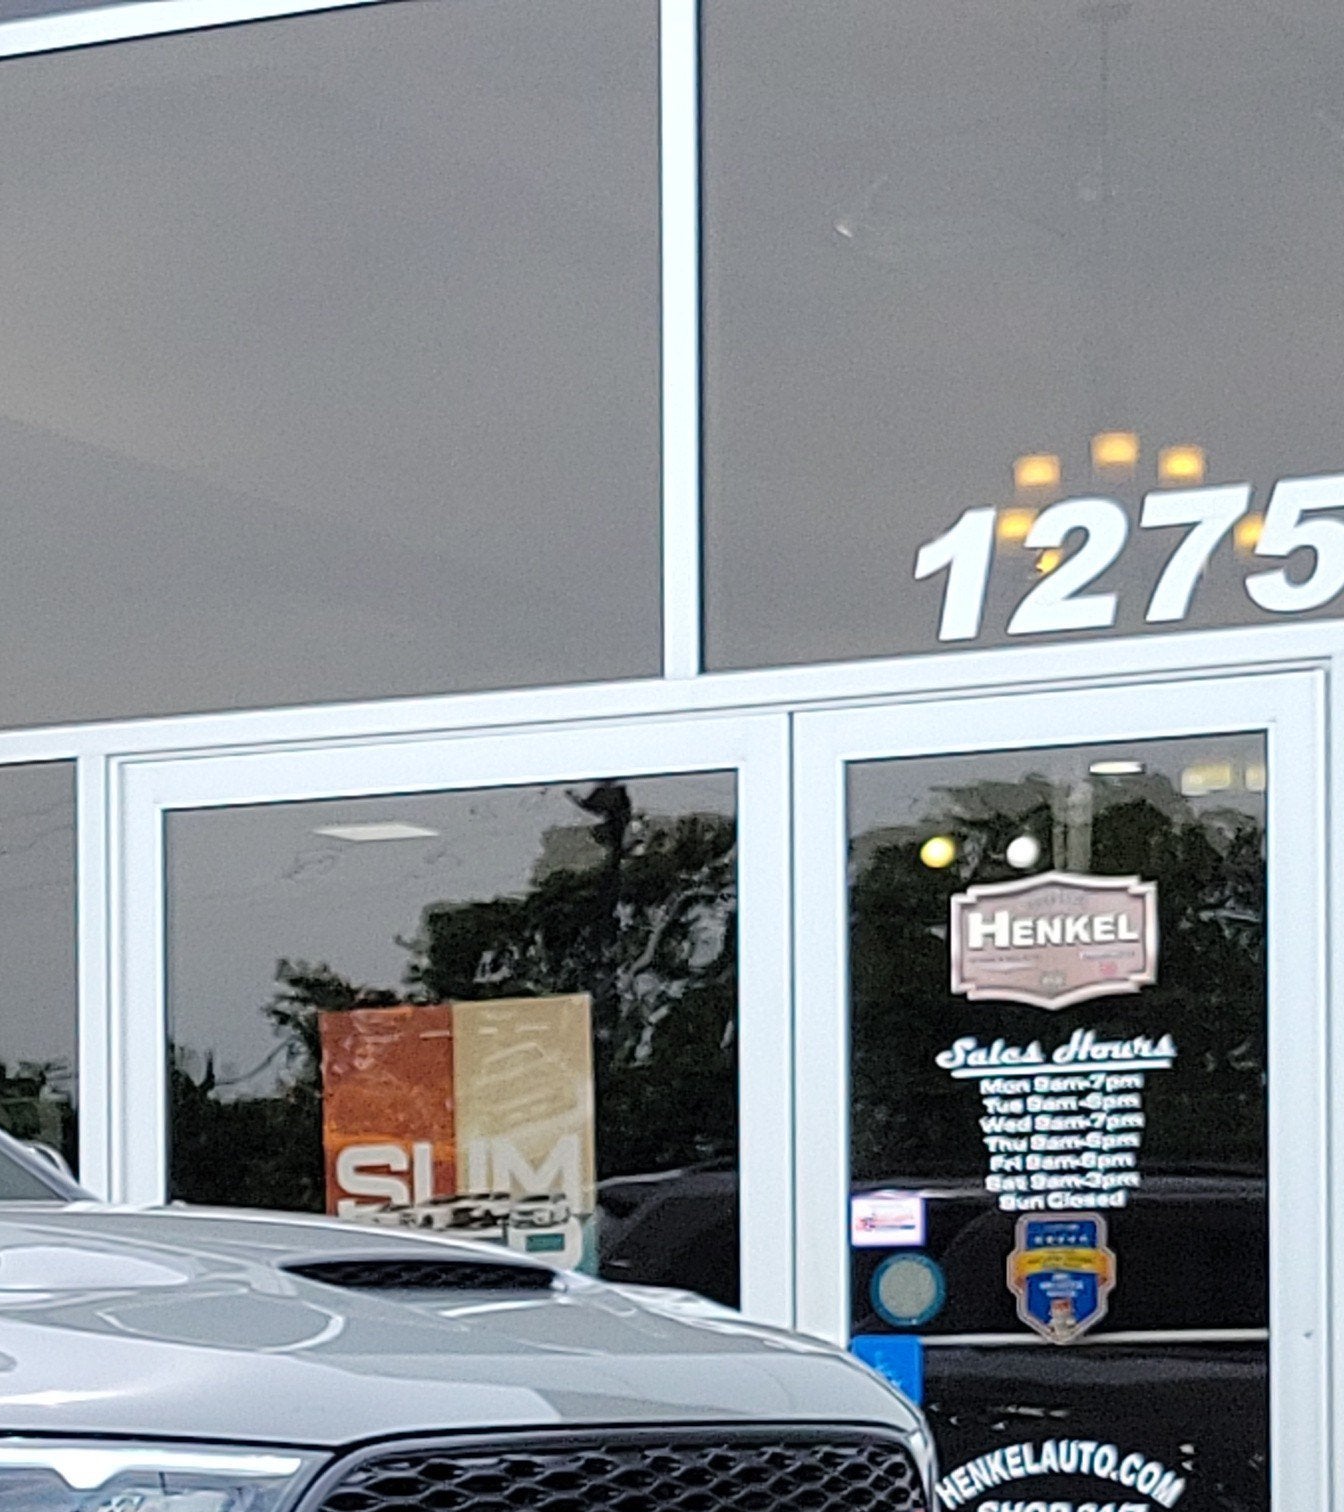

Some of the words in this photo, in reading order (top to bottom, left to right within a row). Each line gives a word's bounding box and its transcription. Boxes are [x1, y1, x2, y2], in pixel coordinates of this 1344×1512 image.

[914, 471, 1344, 643] 1275
[967, 910, 1140, 949] HENKEL
[935, 1037, 1046, 1069] Sales
[1052, 1028, 1178, 1064] Hours
[979, 1078, 1031, 1095] Mon
[982, 1097, 1024, 1114] Tue
[978, 1115, 1032, 1133] Wed
[983, 1136, 1028, 1152] Thu
[989, 1155, 1023, 1171] Fri
[985, 1174, 1028, 1192] Sat
[999, 1194, 1045, 1211] Sun
[1047, 1190, 1130, 1209] Closed
[935, 1438, 1186, 1511] HENKELAUTO.COM
